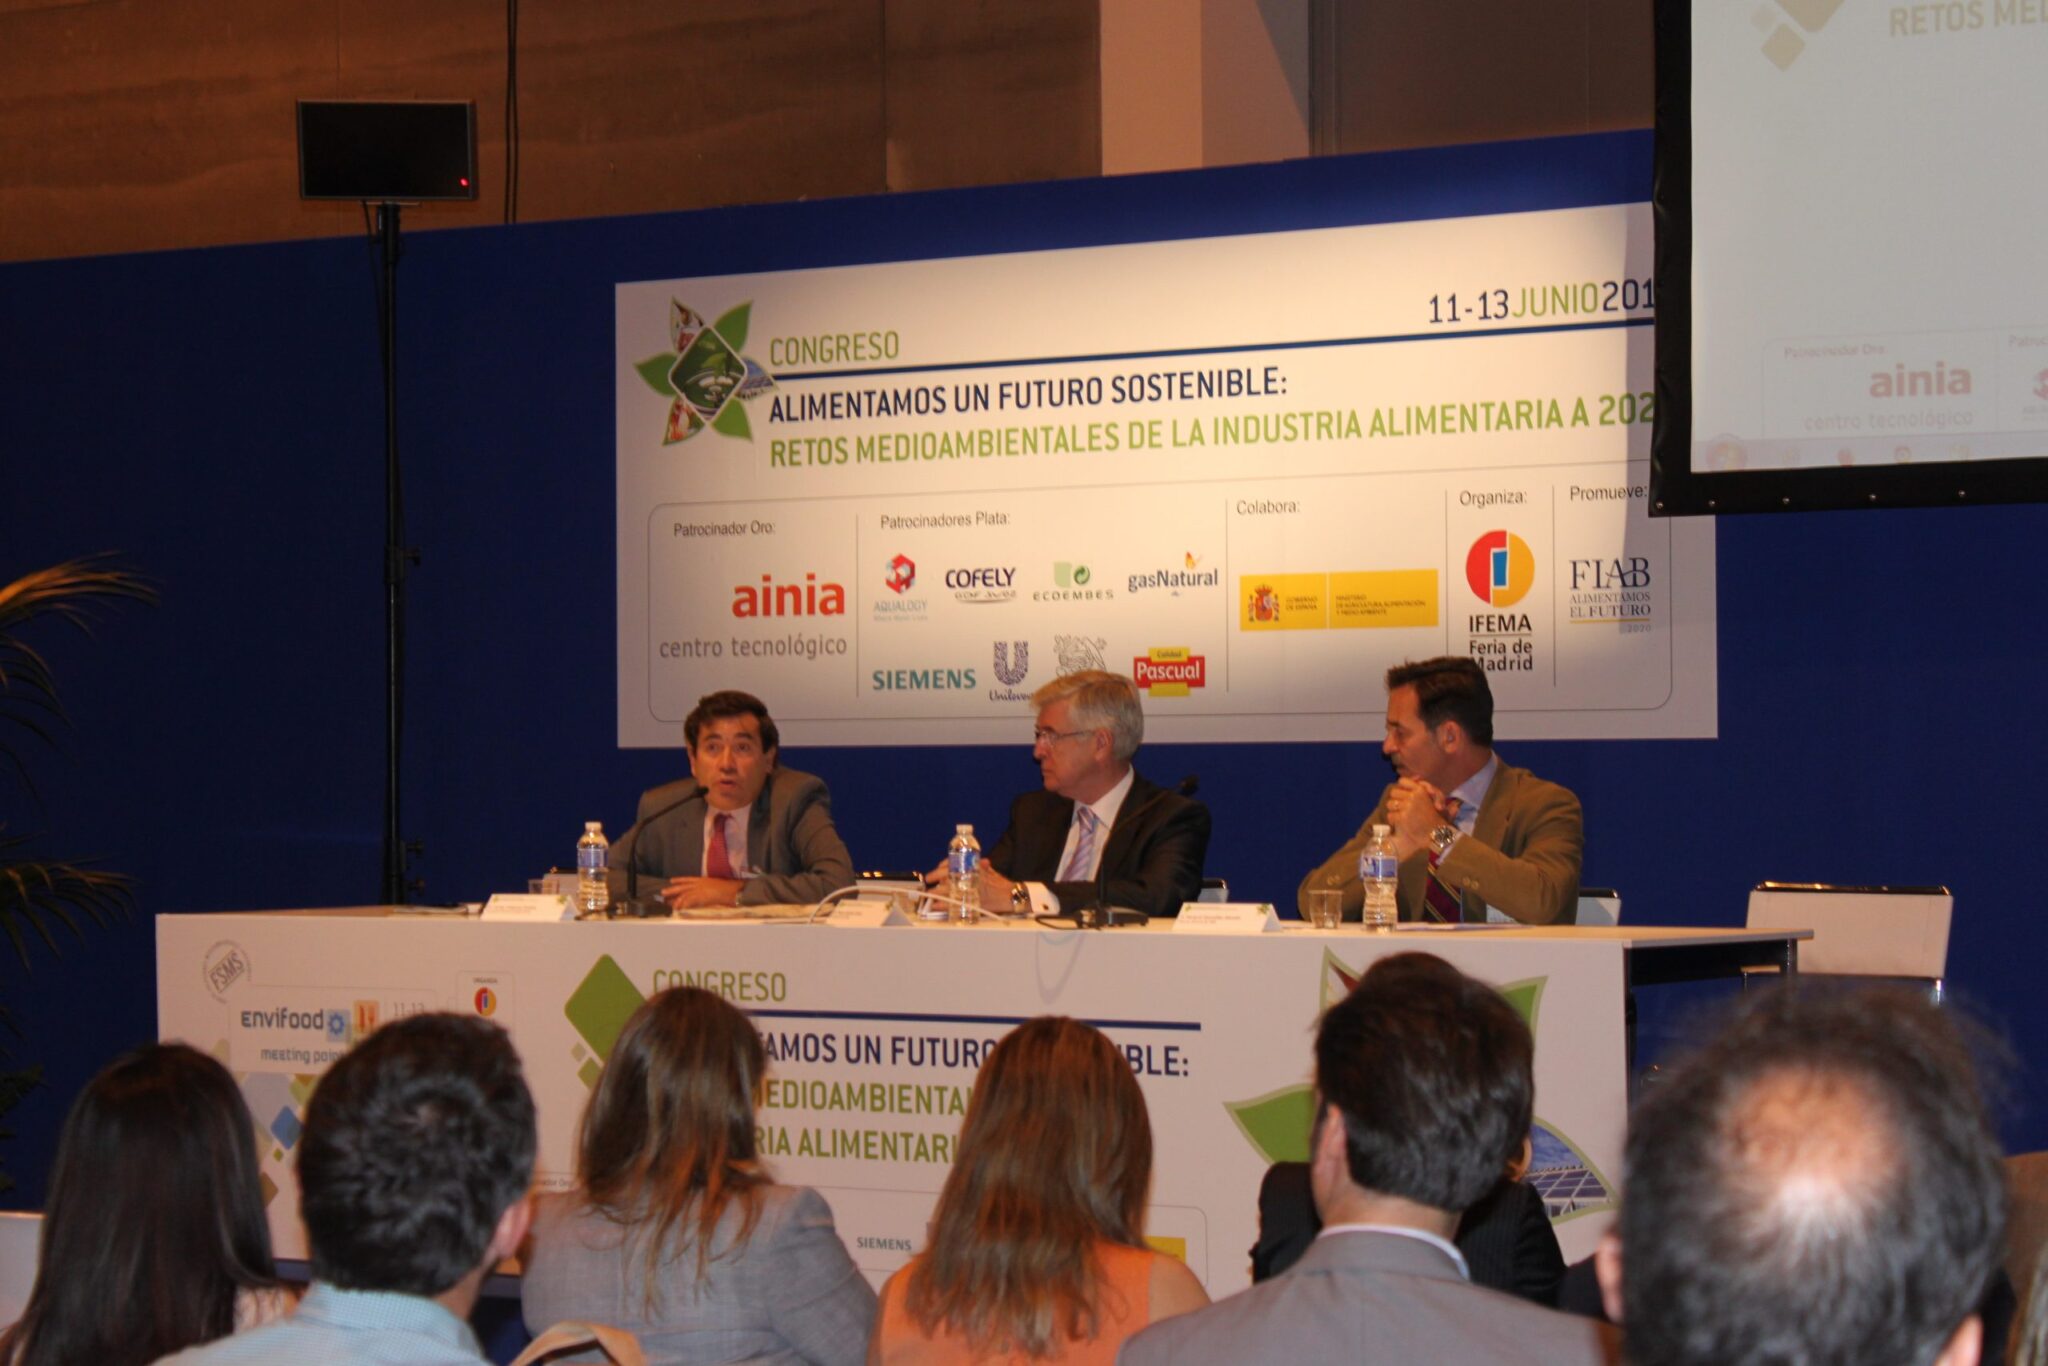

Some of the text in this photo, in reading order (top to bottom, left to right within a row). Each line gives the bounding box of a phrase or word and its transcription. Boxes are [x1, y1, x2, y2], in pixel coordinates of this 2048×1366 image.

[1889, 1, 1984, 37] RETOS
[769, 330, 899, 367] CONGRESO
[1869, 361, 1972, 398] ainia
[769, 366, 1287, 423] ALIMENTAMOS UN FUTURO SOSTENIBLE:
[770, 436, 848, 468] RETOS
[856, 421, 1119, 464] MEDIOAMBIENTALES
[1128, 419, 1163, 449] DE
[1172, 416, 1205, 448] LA
[1213, 405, 1362, 446] INDUSTRIA
[1369, 398, 1562, 437] ALIMENTARIA
[1571, 395, 1589, 427] A
[1459, 489, 1528, 508] Organiza:
[1569, 484, 1648, 502] Promueve:
[1236, 499, 1300, 515] Colabora:
[674, 521, 746, 537] Patrocinador
[880, 511, 1010, 530] Patrocinadores Plata:
[945, 567, 1016, 589] COFELY
[1128, 568, 1219, 593] gasNatural
[1568, 557, 1651, 589] FIAB
[731, 572, 846, 619] ainia
[1032, 589, 1115, 602] ECOEMBES
[1569, 591, 1651, 605] ALIMENTAMOS
[1570, 604, 1651, 618] EL FUTURO
[1469, 614, 1532, 633] IFEMA
[659, 632, 847, 661] centro tecnológico
[1469, 638, 1533, 655] Feria de
[872, 668, 977, 690] SIEMENS
[1136, 660, 1201, 681] Pascual
[845, 1034, 881, 1065] UN
[1117, 1044, 1188, 1077] BLE:
[857, 1236, 912, 1251] SIEMENS
